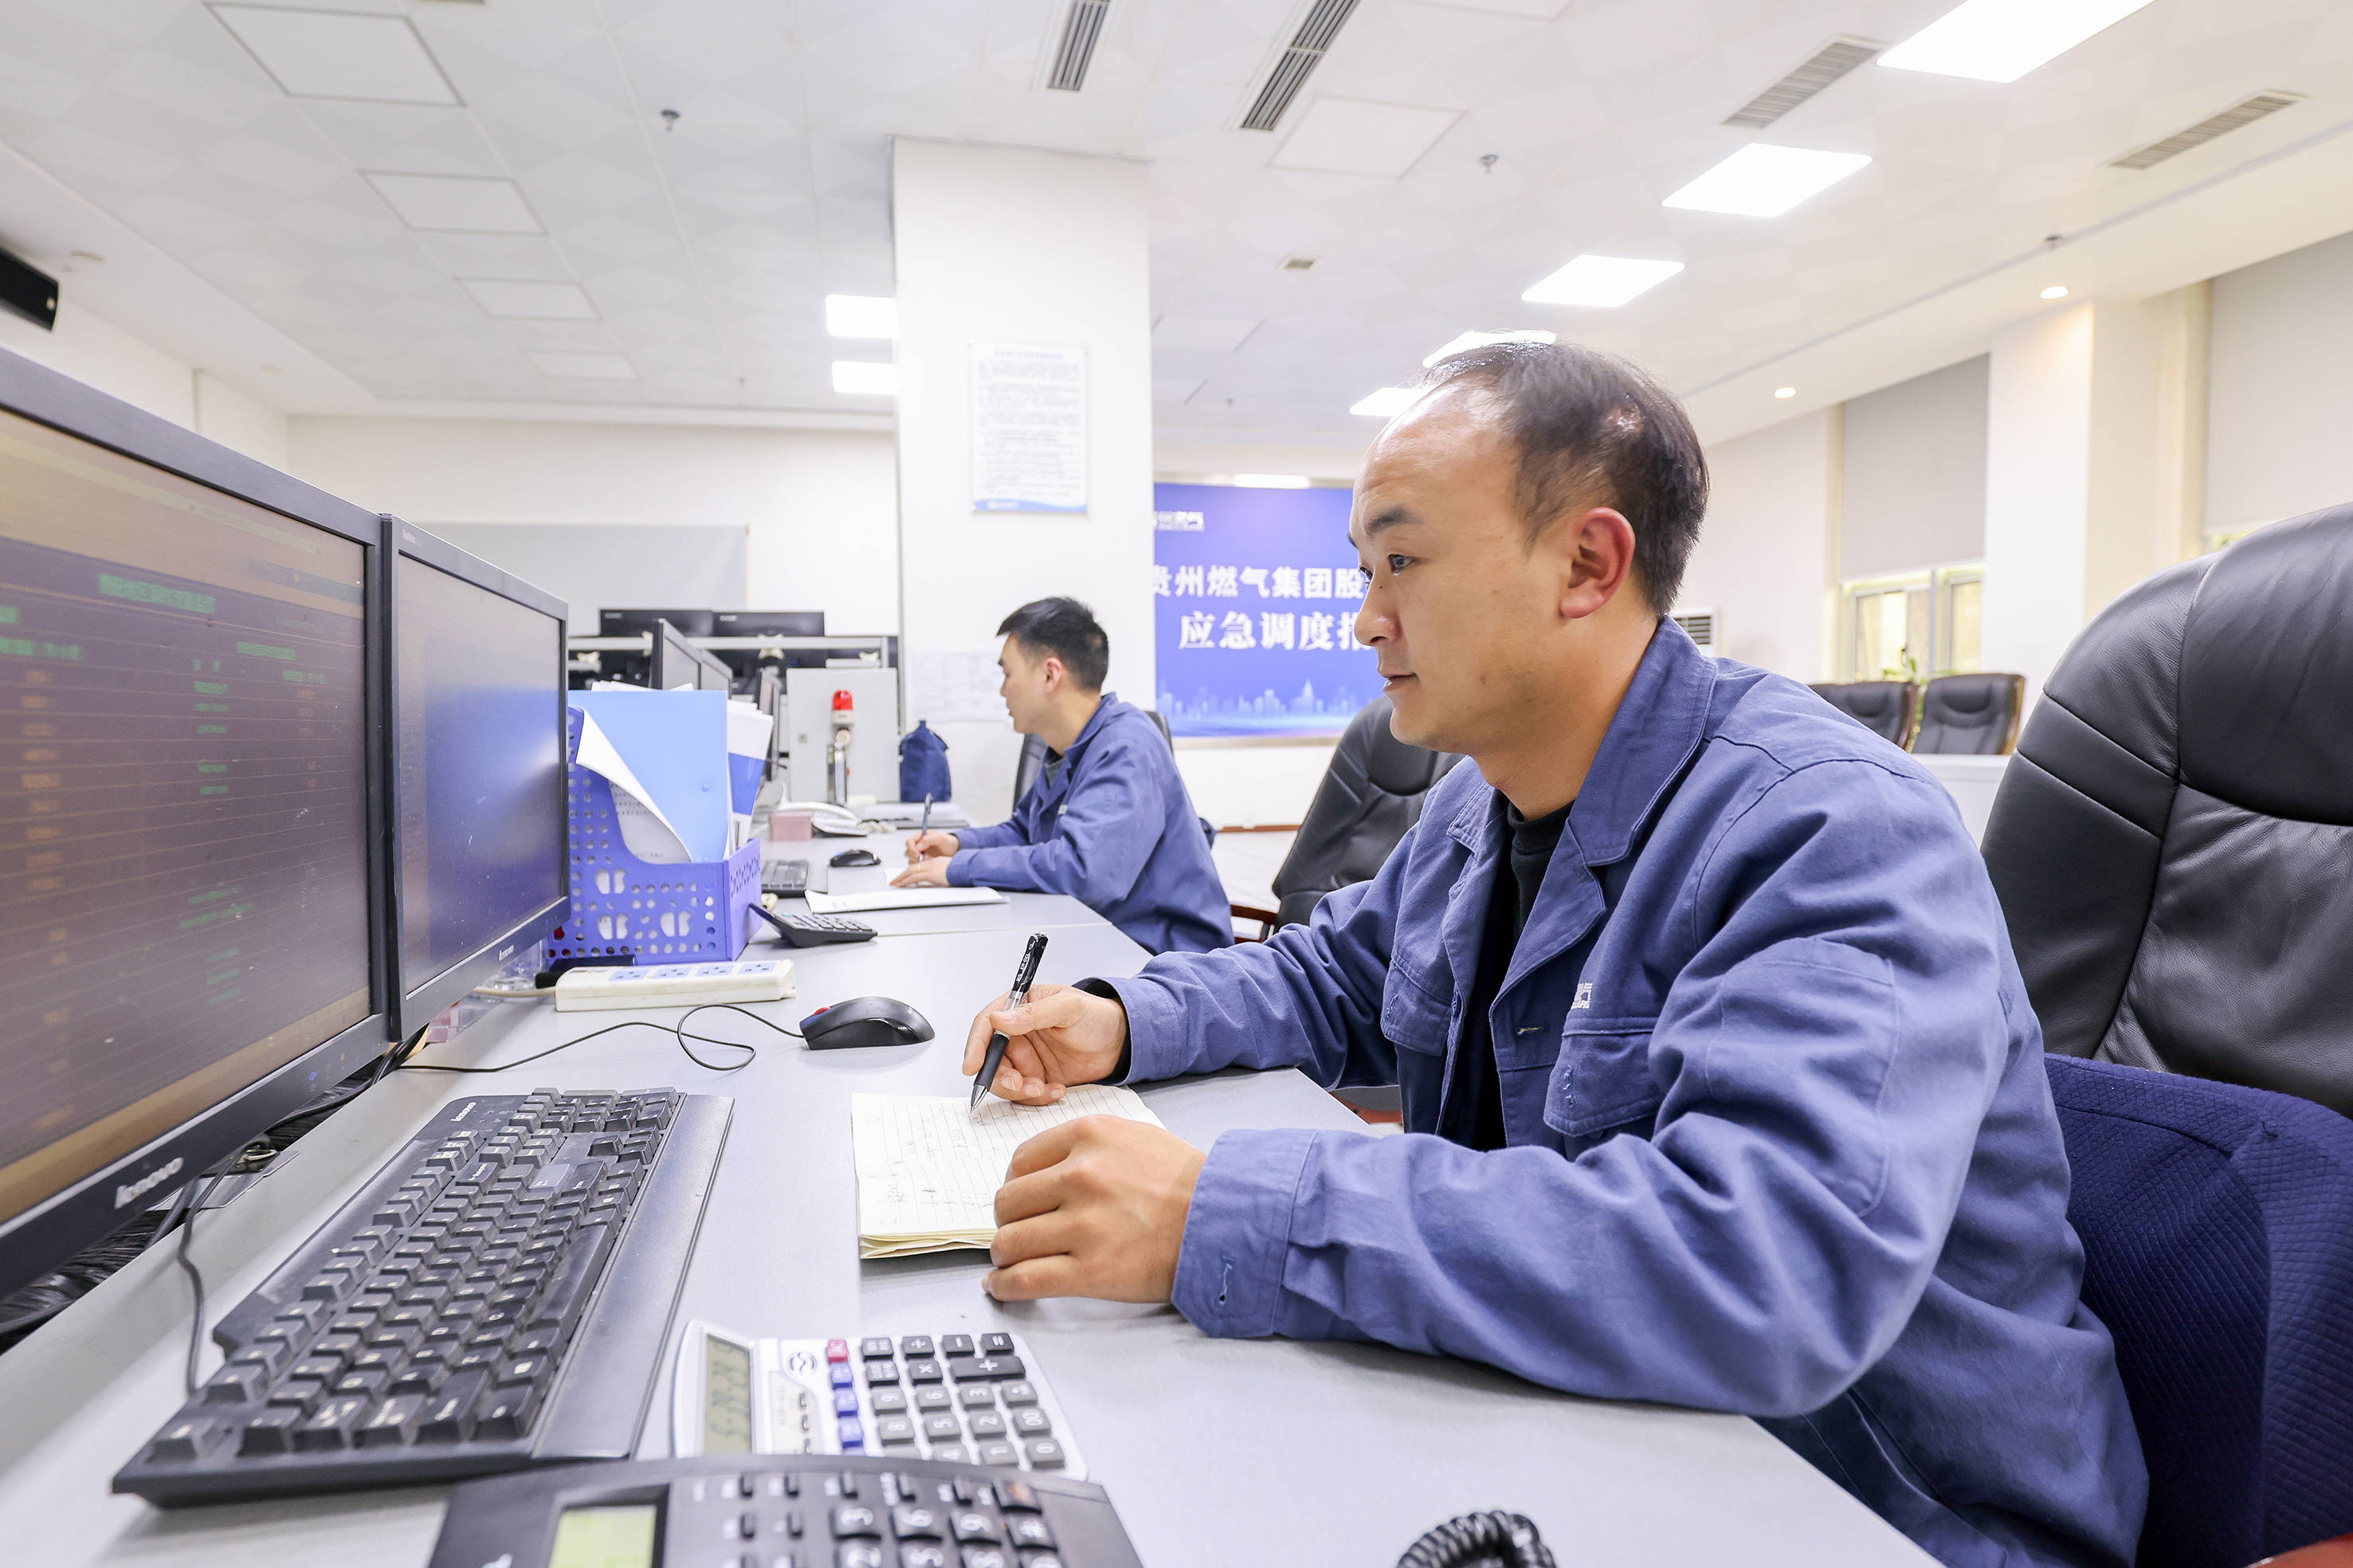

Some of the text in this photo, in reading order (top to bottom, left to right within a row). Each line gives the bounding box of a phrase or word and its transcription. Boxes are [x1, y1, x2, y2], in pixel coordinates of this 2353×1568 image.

[450, 1102, 477, 1122] lenovo
[969, 1388, 988, 1398] 3
[887, 1421, 908, 1433] 8
[932, 1418, 954, 1430] 5
[978, 1417, 998, 1426] 2
